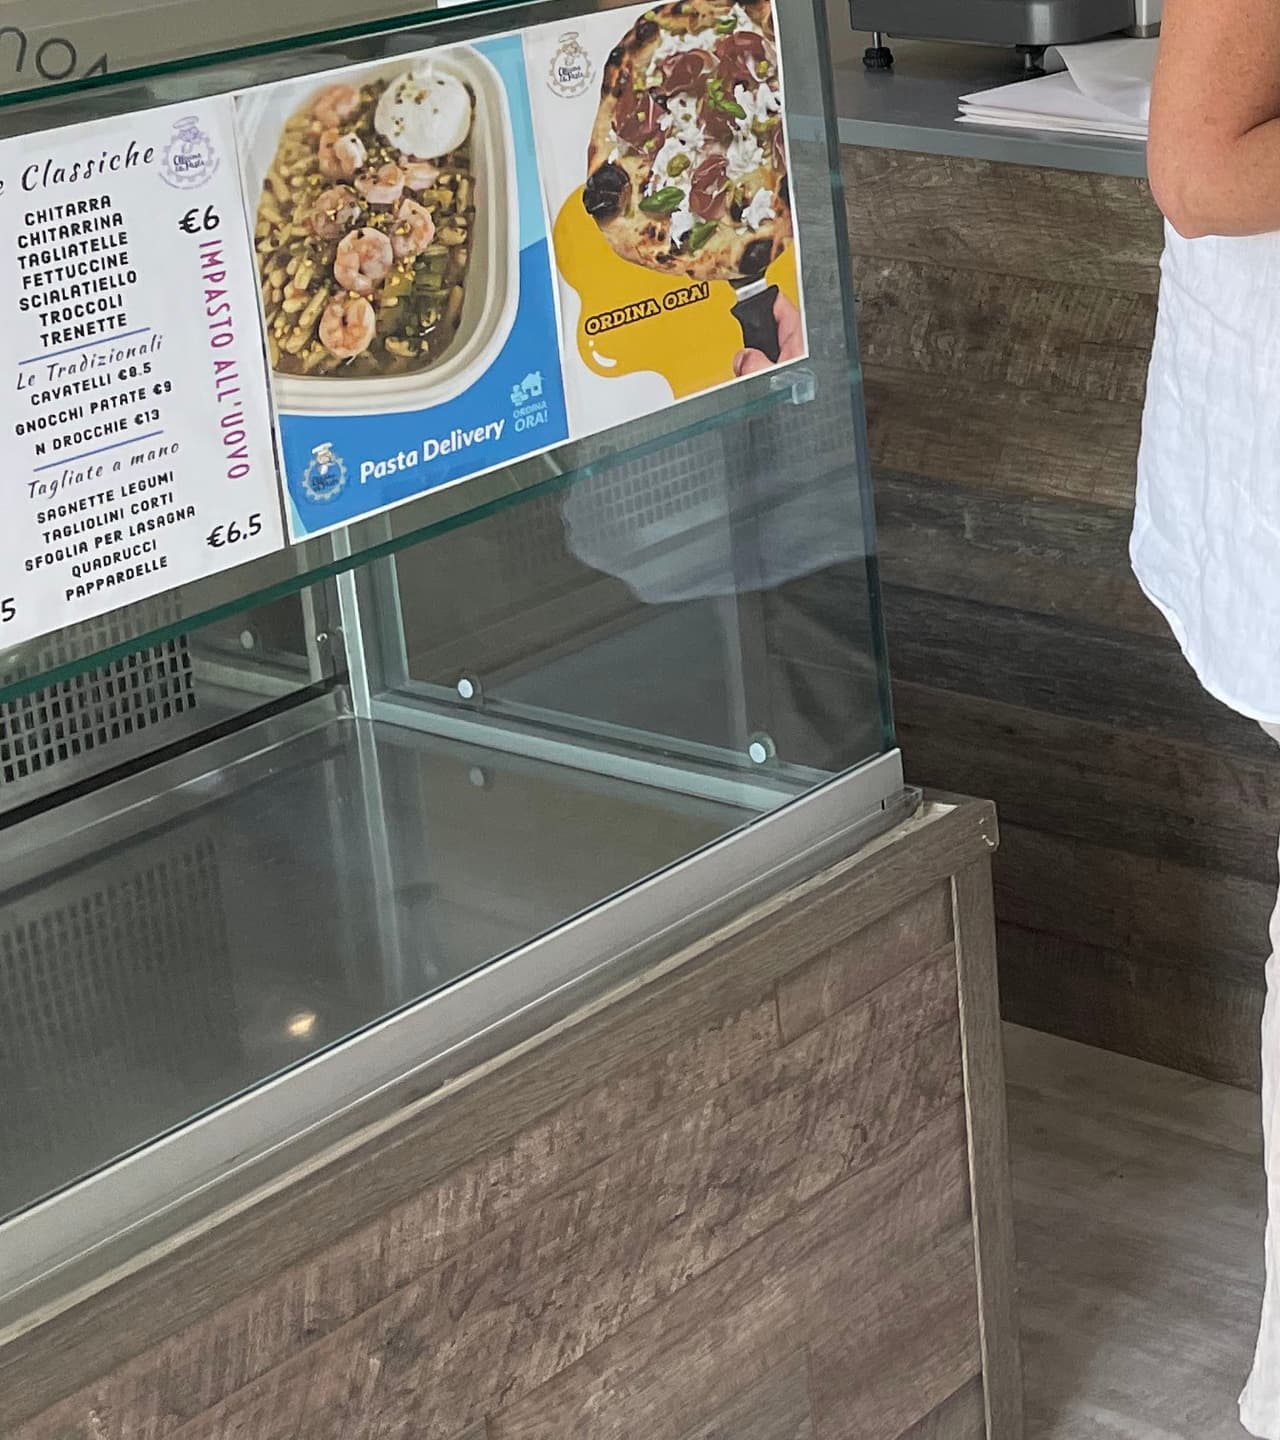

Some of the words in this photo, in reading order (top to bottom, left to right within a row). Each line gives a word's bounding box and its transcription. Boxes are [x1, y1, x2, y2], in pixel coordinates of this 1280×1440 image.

[21, 140, 154, 192] Classiche
[17, 212, 123, 249] CHITARRINA
[24, 195, 112, 226] CHITARRA
[178, 204, 221, 234] €6
[17, 231, 129, 270] TAGLIATELLE
[22, 251, 129, 290] FETTUCCINE
[19, 270, 137, 312] SCIALATIELLO
[39, 293, 124, 328] TROCCOLI
[198, 239, 235, 349] IMPASTO
[585, 298, 661, 336] ORDINA
[663, 281, 710, 310] ORA!
[39, 312, 128, 348] TRENETTE
[47, 333, 163, 380] Tradizionali
[15, 406, 84, 436] GNOCCHI
[90, 387, 147, 414] PATATE
[152, 380, 173, 396] €9
[31, 373, 111, 406] CAVATELLI
[512, 400, 548, 419] ORDINA
[52, 417, 128, 451] DROCCHIE
[134, 408, 160, 426] €13
[213, 360, 250, 480] ALL'UOVO
[514, 410, 549, 433] ORA!
[27, 464, 104, 500] Tagliate
[112, 459, 122, 472] a
[130, 441, 180, 467] mano
[359, 448, 418, 484] Pasta
[422, 418, 505, 462] Delivery
[36, 490, 115, 525] SAGNETTE
[120, 470, 174, 498] LEGUMI
[42, 507, 125, 544] TAGLIOLINI
[130, 492, 174, 516] CORTI
[24, 541, 88, 572] SFOGLIA
[94, 529, 123, 550] PER
[129, 505, 196, 538] LASAGNA
[206, 512, 262, 549] €6.5
[65, 556, 168, 601] PAPPARDELLE
[71, 539, 157, 578] QUADRUCCI
